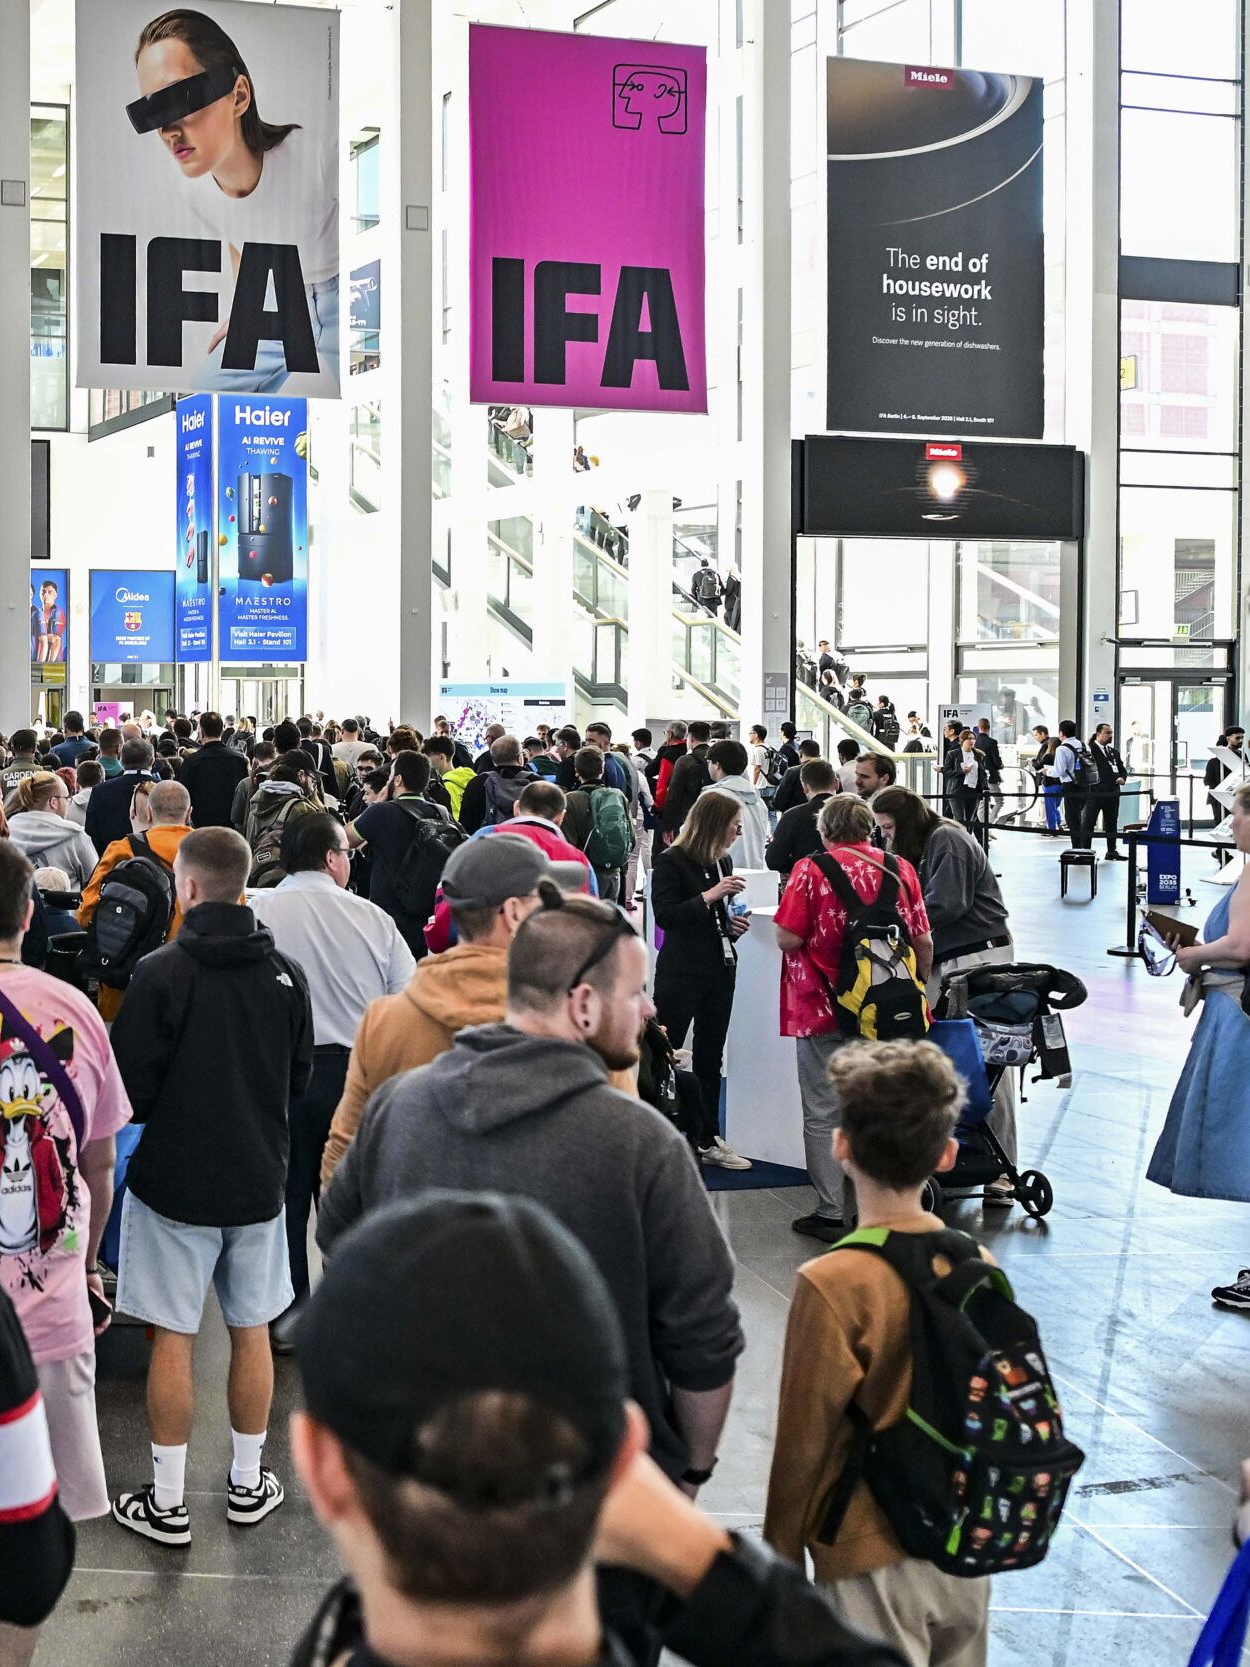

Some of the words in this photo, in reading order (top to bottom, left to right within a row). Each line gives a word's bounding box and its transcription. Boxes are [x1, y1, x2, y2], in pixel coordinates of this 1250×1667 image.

[910, 71, 948, 83] Miele
[885, 247, 920, 269] The
[925, 252, 963, 272] end
[968, 253, 989, 273] of
[882, 273, 992, 300] housework
[100, 233, 320, 374] IFA
[892, 302, 906, 322] is
[912, 303, 928, 323] in
[933, 305, 982, 330] sight.
[491, 257, 690, 391] IFA
[872, 336, 898, 345] Discover
[899, 337, 910, 346] the
[924, 340, 956, 349] generation
[956, 340, 963, 348] of
[963, 341, 1001, 351] dishwashers.
[181, 409, 205, 434] Haier
[234, 405, 292, 426] Haier
[241, 436, 251, 445] AI
[253, 436, 285, 446] REVIVE
[246, 447, 280, 455] THAWING
[115, 587, 150, 603] Midea
[235, 597, 291, 606] MAESTRO
[234, 630, 248, 638] Visit
[249, 630, 266, 638] Haier
[267, 630, 292, 638] Pavilion
[943, 709, 958, 718] IFA
[1, 1185, 32, 1195] adidas
